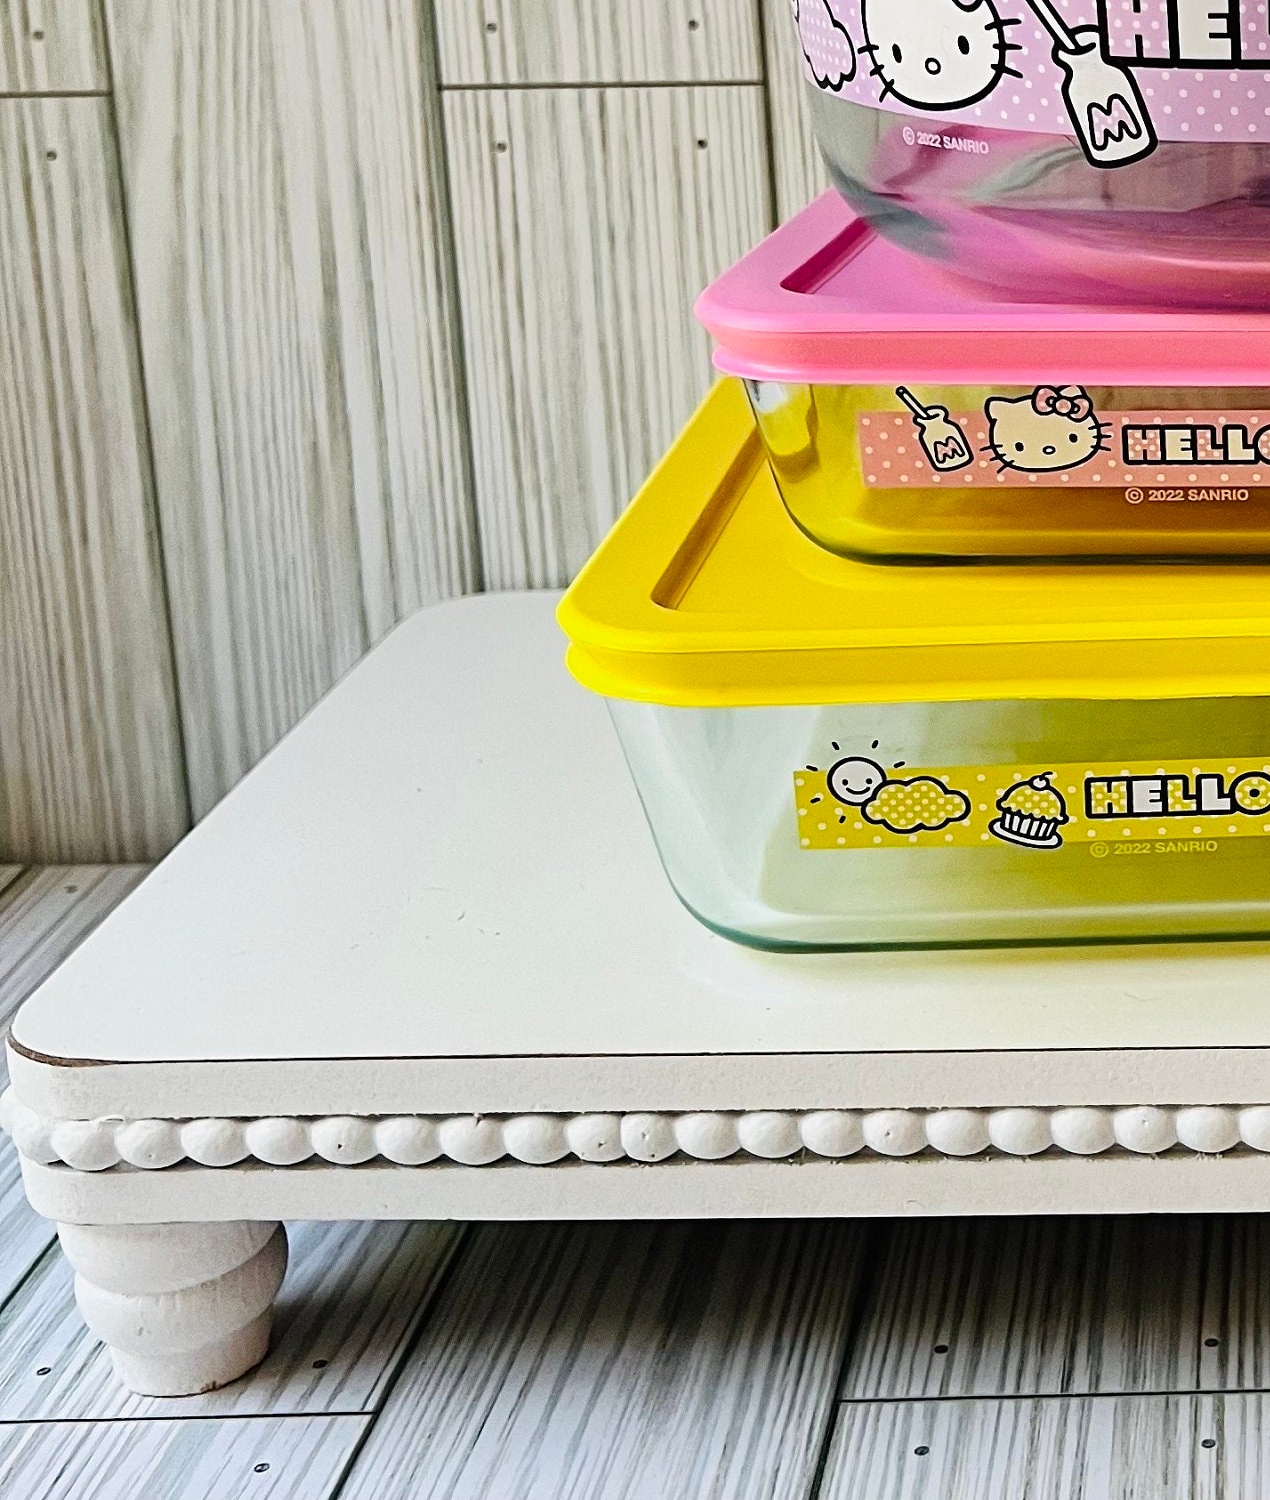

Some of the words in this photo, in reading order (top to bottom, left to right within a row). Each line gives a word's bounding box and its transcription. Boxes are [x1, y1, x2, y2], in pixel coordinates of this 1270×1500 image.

[917, 131, 942, 148] 2022
[943, 135, 990, 155] SANRIO
[1148, 489, 1185, 501] 2022
[1188, 489, 1249, 501] SANRIO
[1114, 843, 1151, 855] 2022
[1155, 840, 1218, 853] SANRIO
